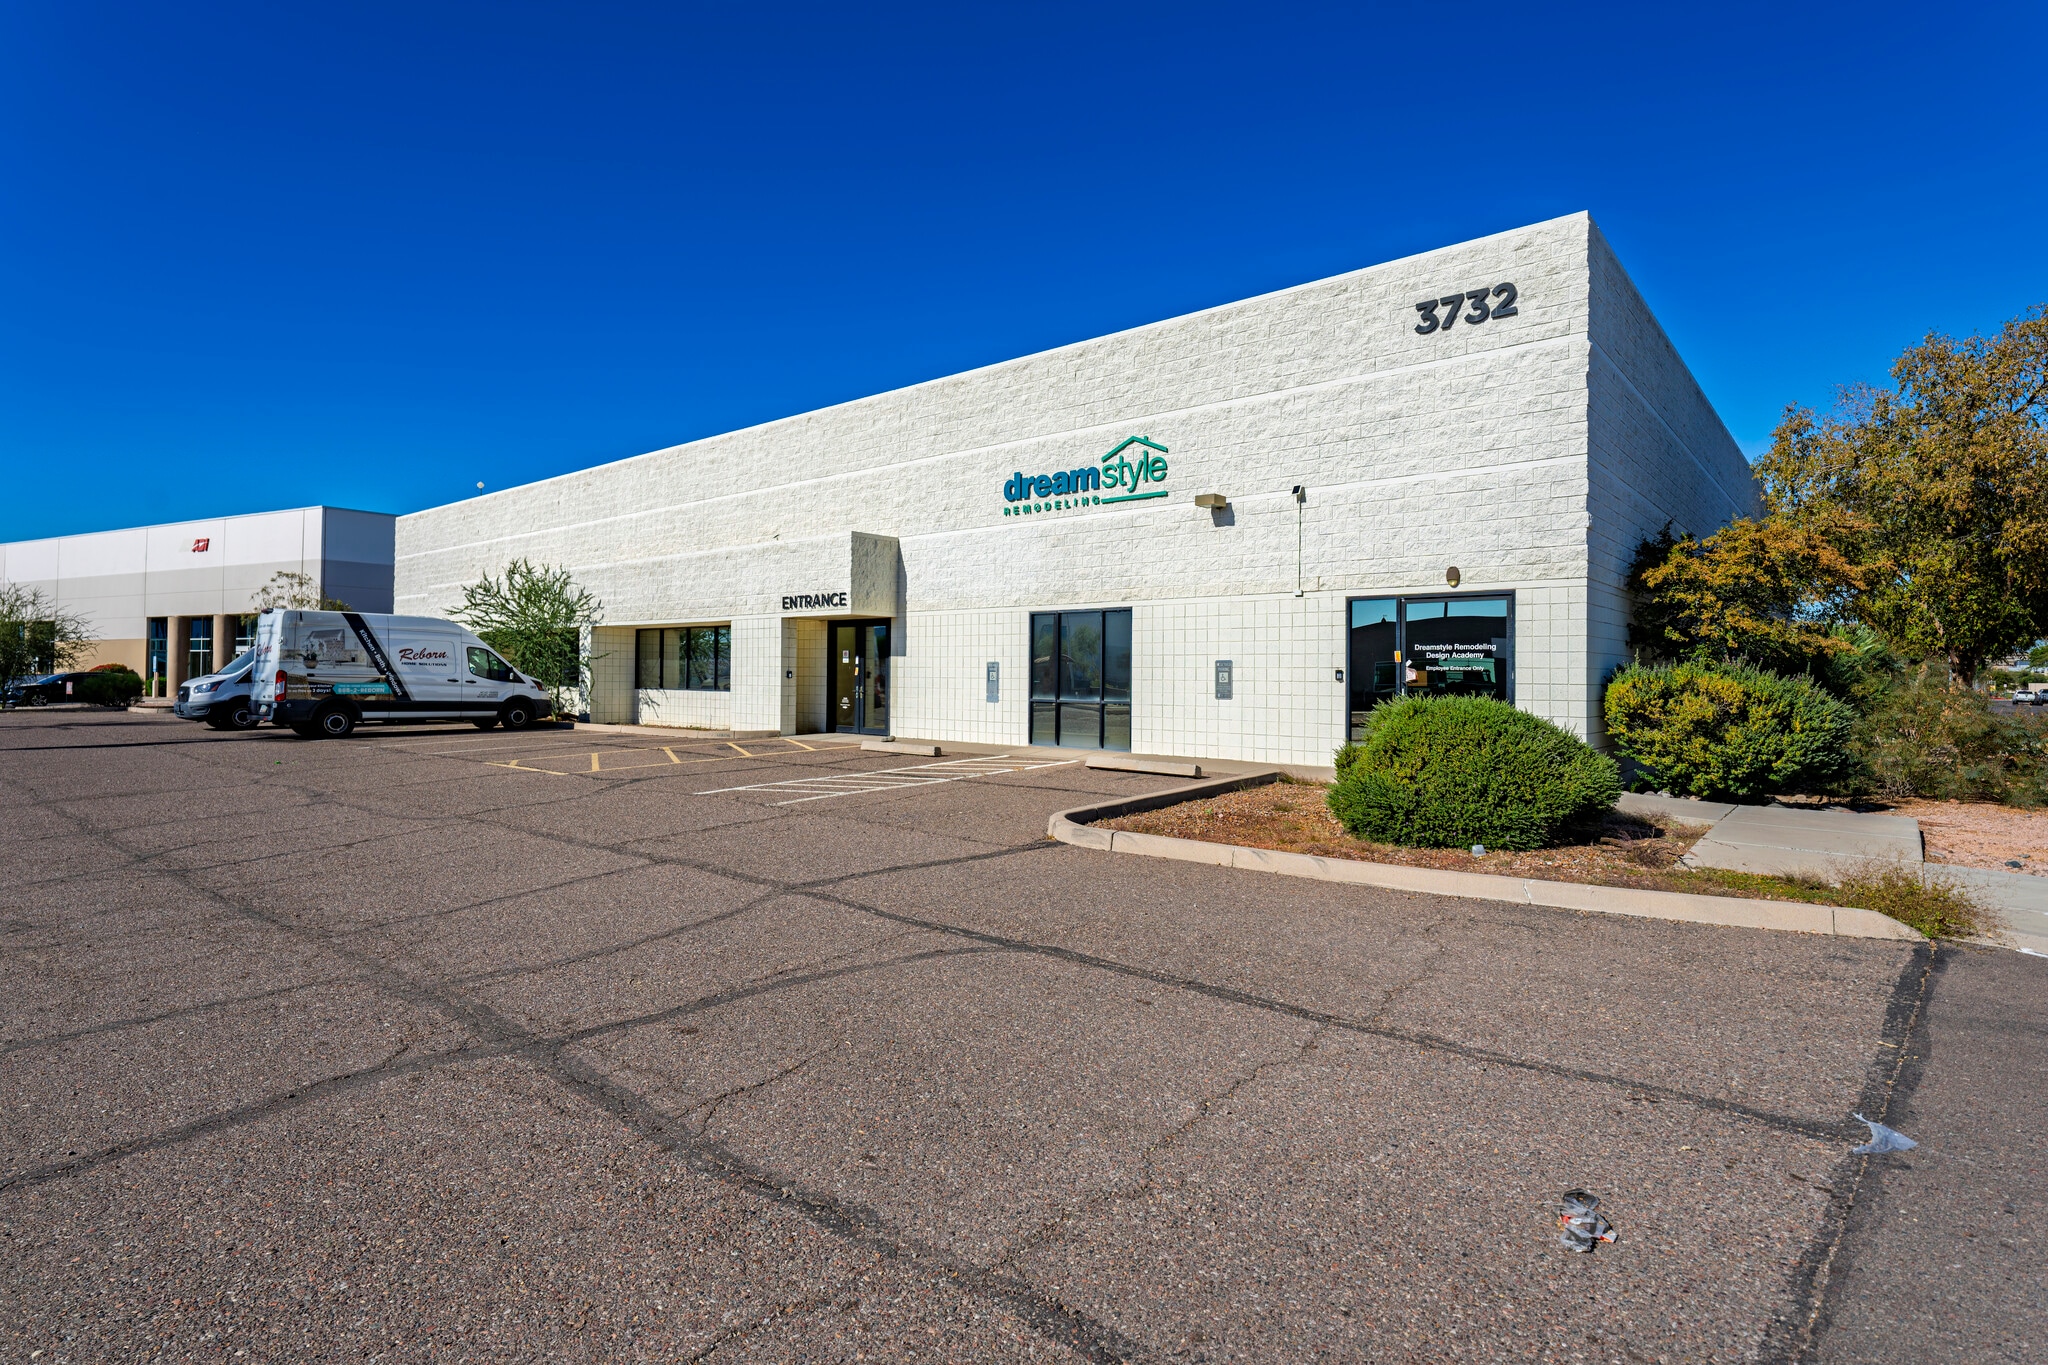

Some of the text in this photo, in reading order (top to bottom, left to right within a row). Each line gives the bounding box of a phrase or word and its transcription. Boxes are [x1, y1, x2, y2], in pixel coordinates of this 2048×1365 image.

[1414, 282, 1518, 335] 3732
[1003, 495, 1100, 517] REMODELING
[782, 592, 847, 610] ENTRANCE
[359, 629, 376, 652] Kitchen
[374, 653, 386, 669] Bath
[399, 647, 447, 661] Reborn
[1414, 643, 1497, 652] Dreamstyle Remodeling
[1426, 652, 1450, 660] Design
